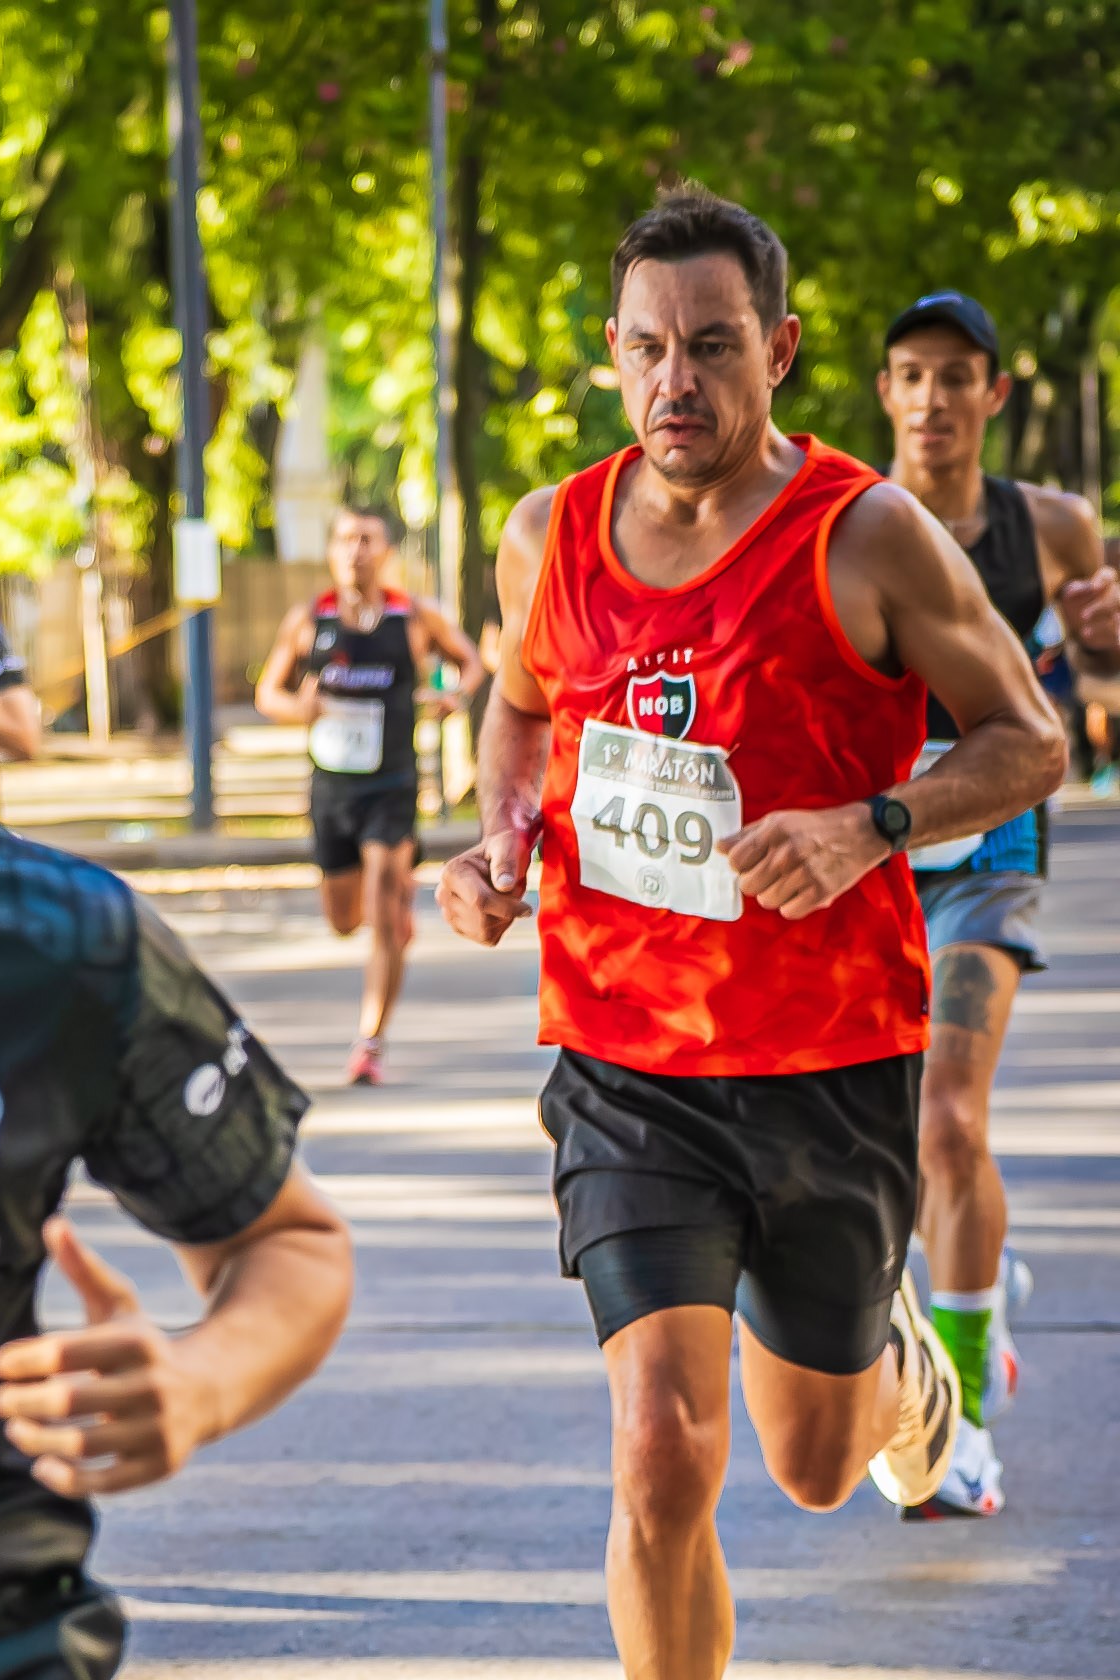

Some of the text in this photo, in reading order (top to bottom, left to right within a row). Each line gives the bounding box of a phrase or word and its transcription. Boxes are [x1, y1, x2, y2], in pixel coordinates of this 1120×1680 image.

[638, 694, 685, 717] NOB
[624, 748, 716, 786] MARATÓN
[592, 796, 713, 865] 409
